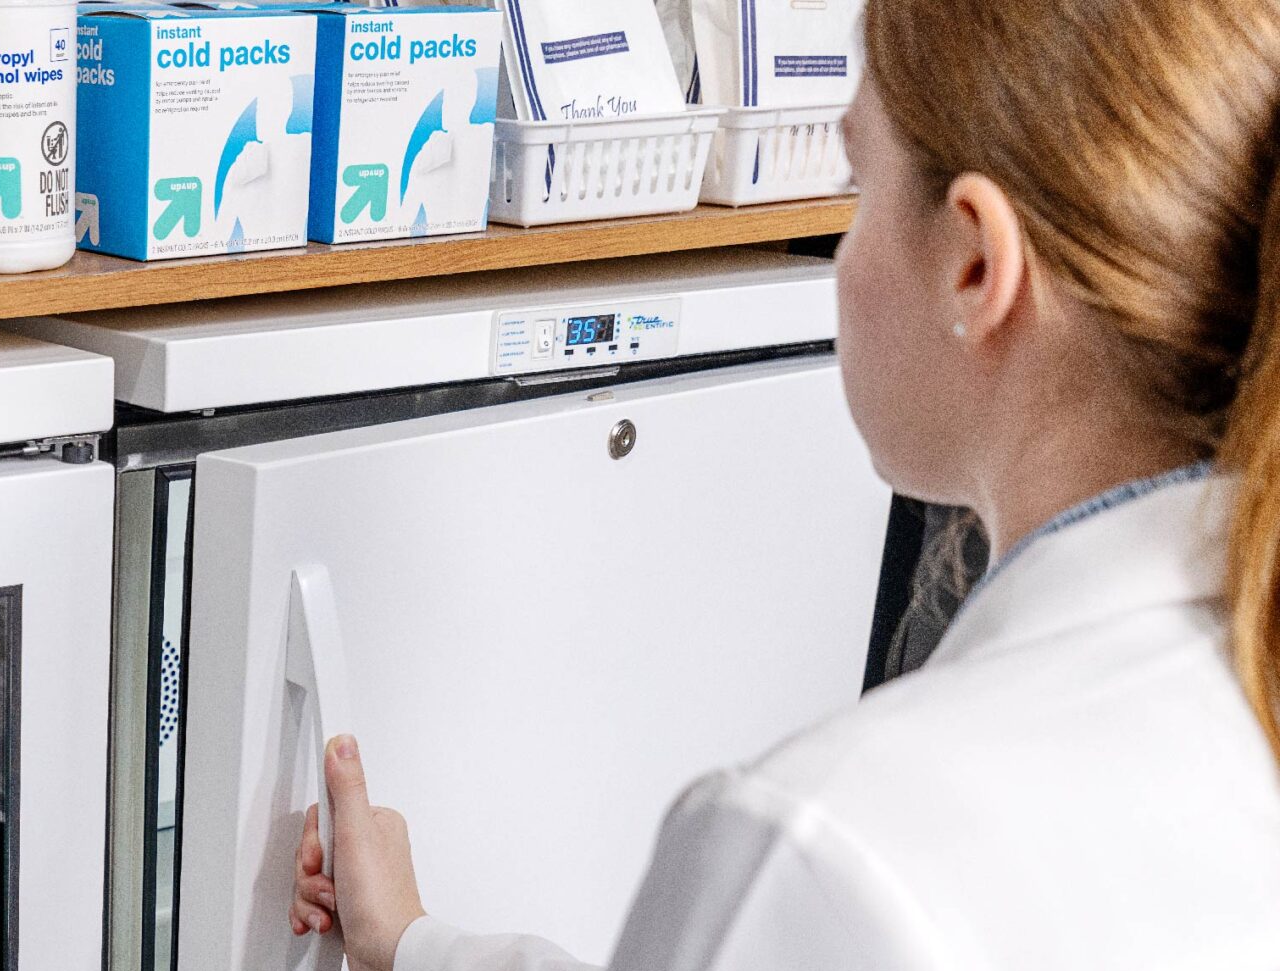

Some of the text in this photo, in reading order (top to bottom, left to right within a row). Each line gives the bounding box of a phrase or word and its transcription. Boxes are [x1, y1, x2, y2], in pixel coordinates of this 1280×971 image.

[76, 24, 99, 36] nstant
[156, 26, 202, 40] instant
[351, 20, 394, 33] instant
[55, 39, 66, 51] 40
[76, 38, 103, 61] cold
[157, 39, 291, 72] cold packs
[350, 33, 477, 64] cold packs
[24, 67, 63, 85] wipes
[76, 63, 115, 86] packs
[560, 94, 637, 120] Thank You
[39, 167, 69, 194] DO NOT
[45, 191, 69, 217] FLUSH
